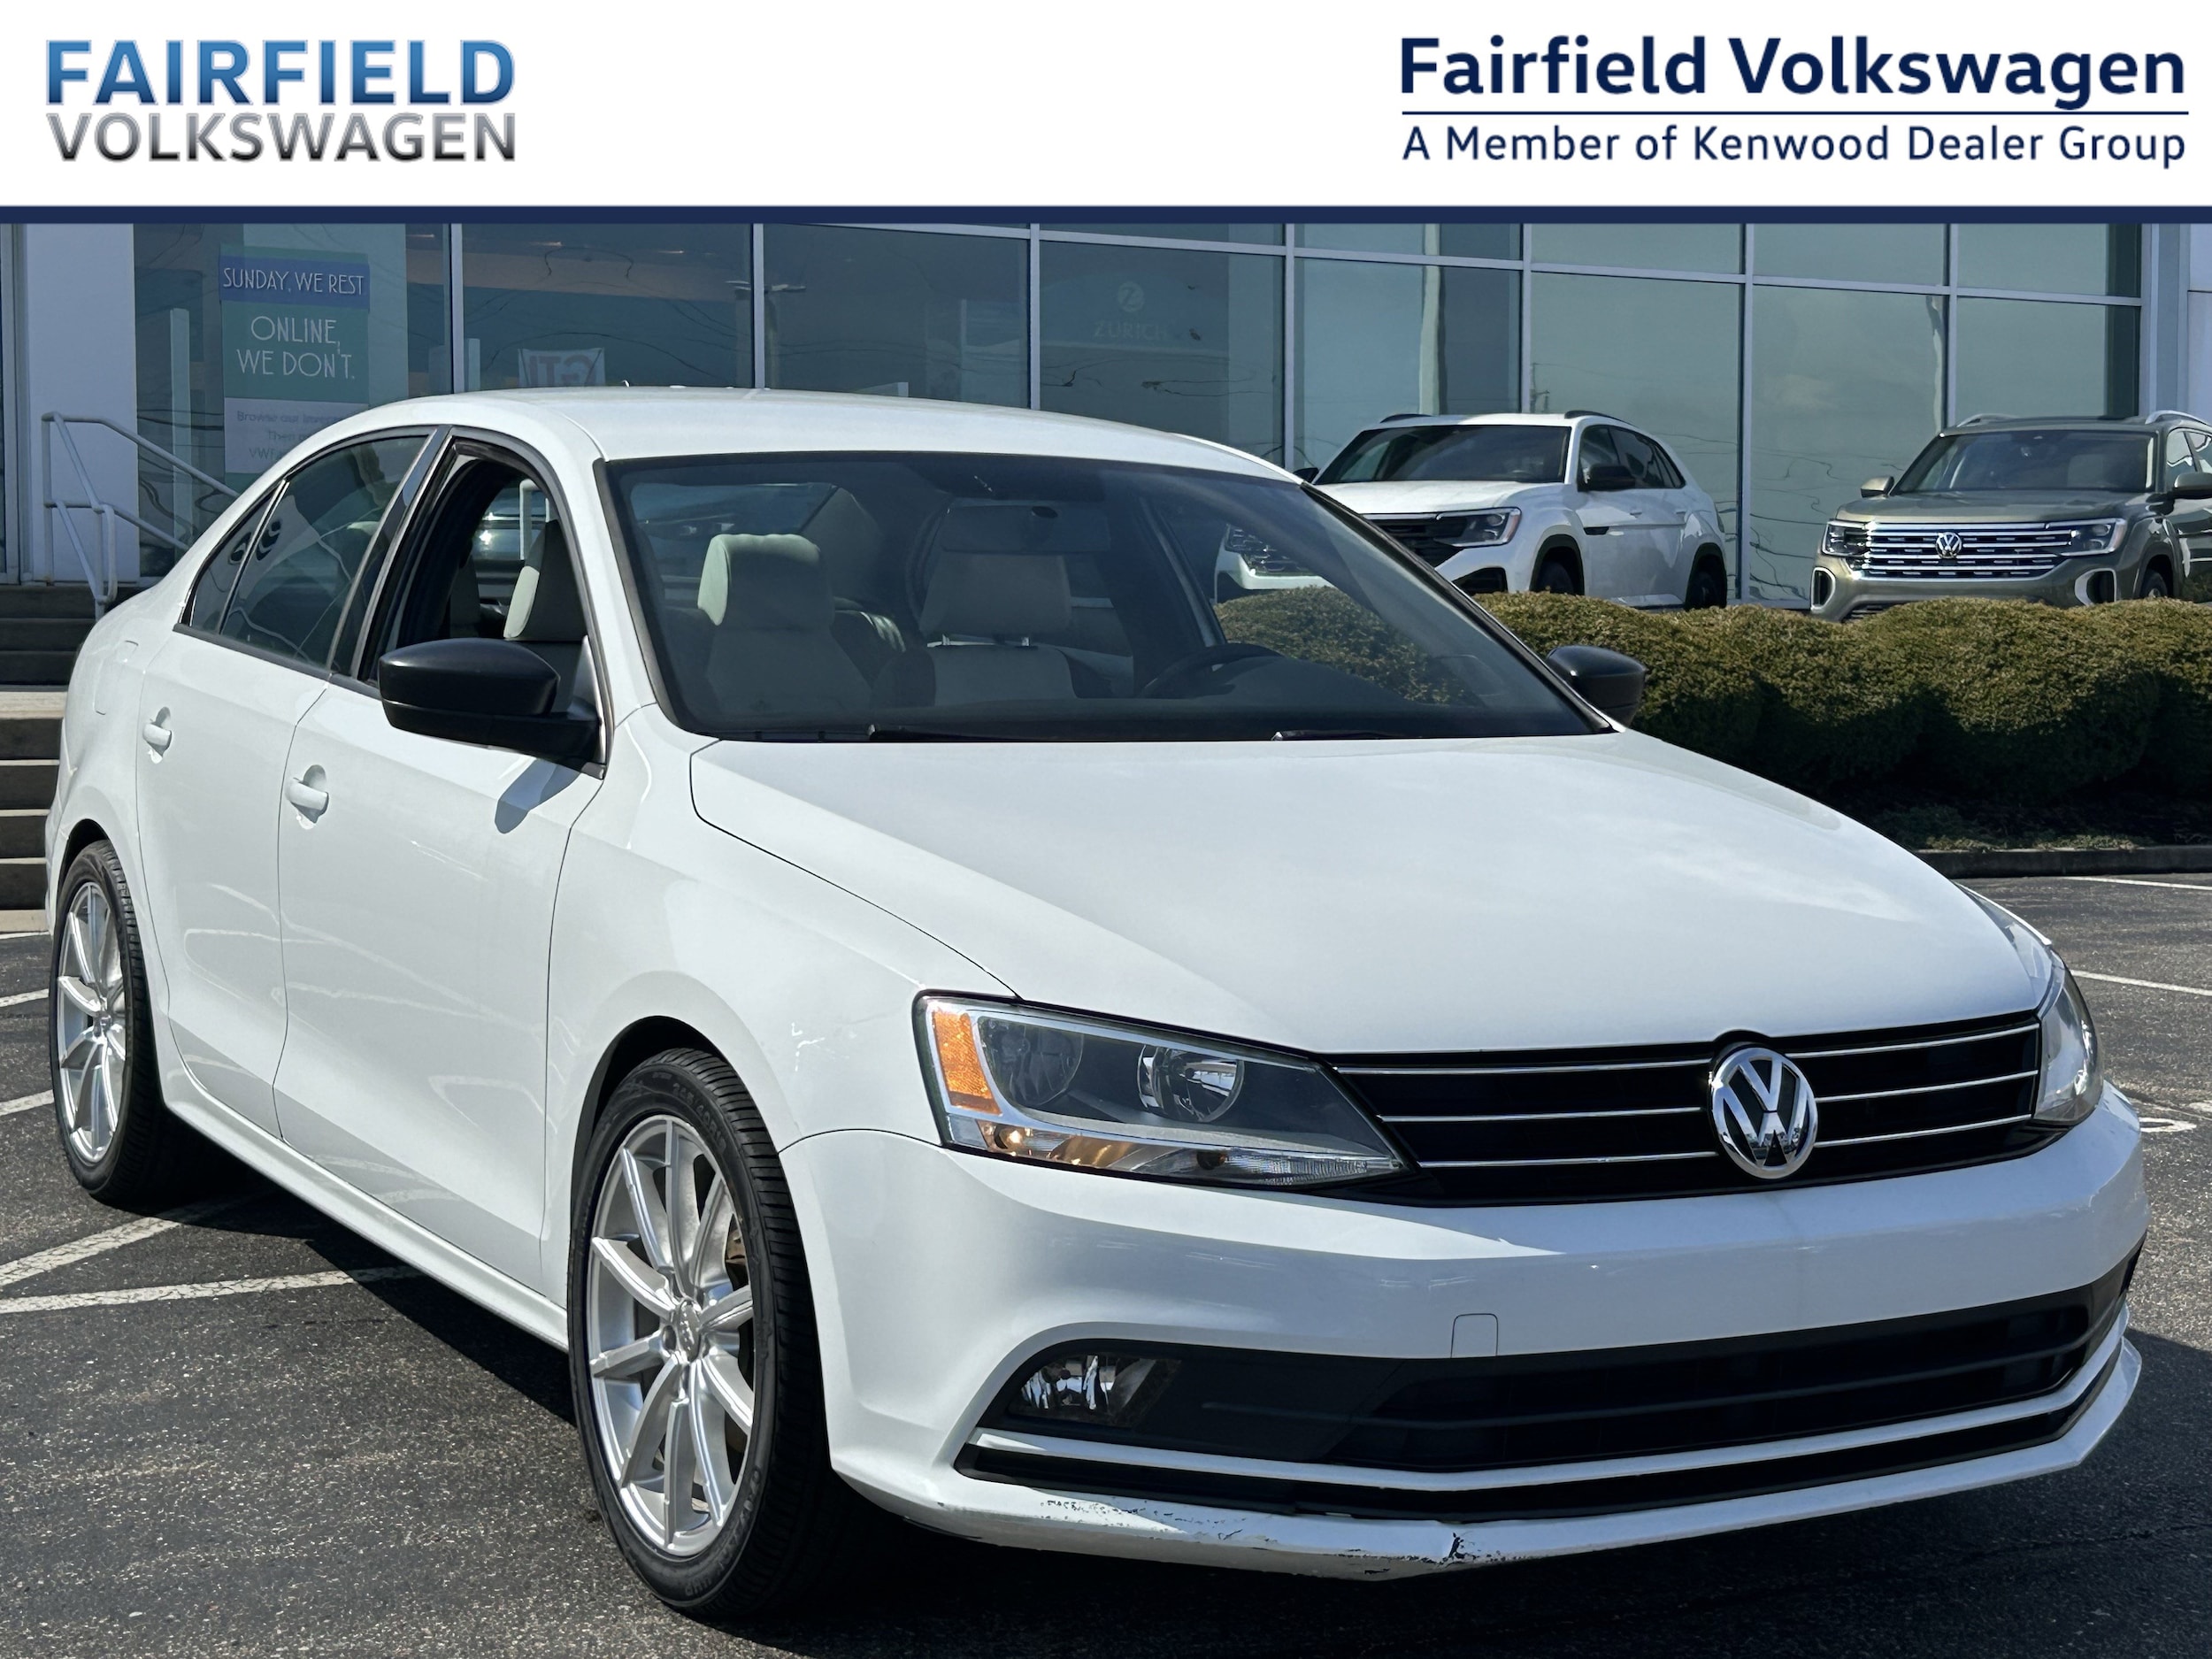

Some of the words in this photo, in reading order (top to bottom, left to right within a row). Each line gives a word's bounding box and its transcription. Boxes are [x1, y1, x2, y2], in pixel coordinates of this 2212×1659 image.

[294, 272, 324, 293] WE
[328, 274, 365, 296] REST
[236, 349, 274, 375] WE
[1711, 1047, 1819, 1179] VW
